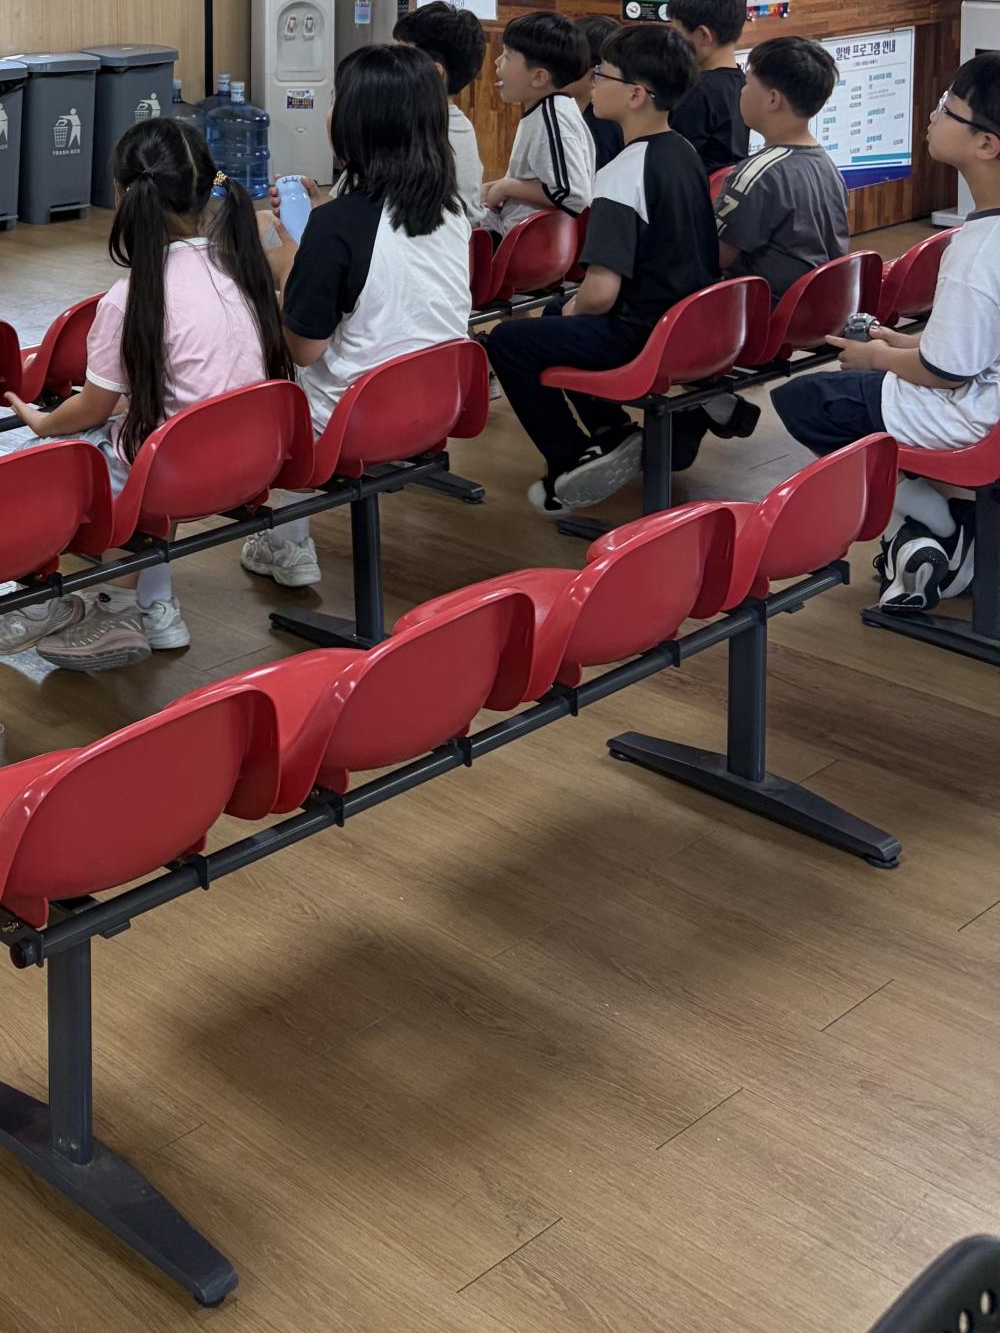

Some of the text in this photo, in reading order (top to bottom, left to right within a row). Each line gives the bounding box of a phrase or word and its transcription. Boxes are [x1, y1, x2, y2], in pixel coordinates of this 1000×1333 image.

[835, 39, 897, 61] 일반 프로그램 안내
